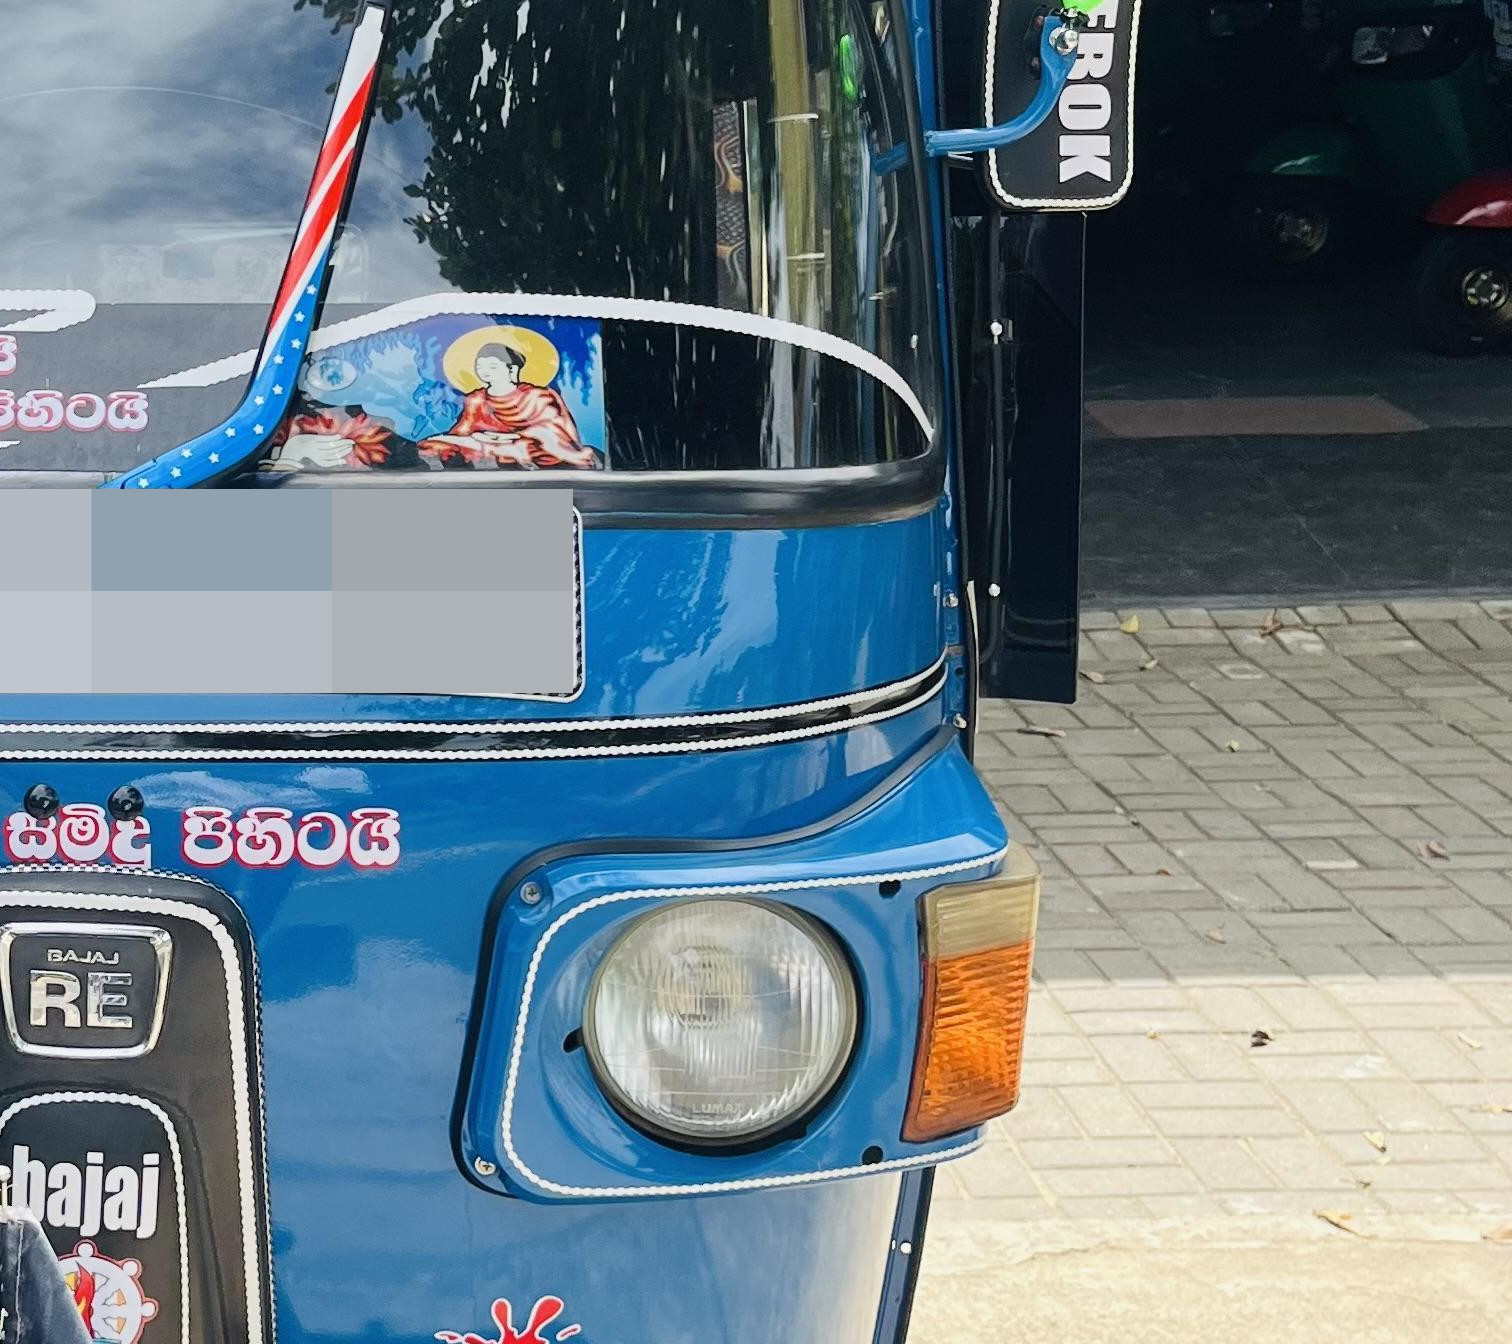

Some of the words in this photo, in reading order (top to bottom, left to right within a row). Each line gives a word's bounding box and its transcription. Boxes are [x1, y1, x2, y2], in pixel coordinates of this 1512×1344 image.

[182, 805, 402, 871] පිහිටයි
[48, 949, 120, 965] BAJAJ
[29, 969, 133, 1028] RE
[11, 1144, 160, 1239] bajaj
